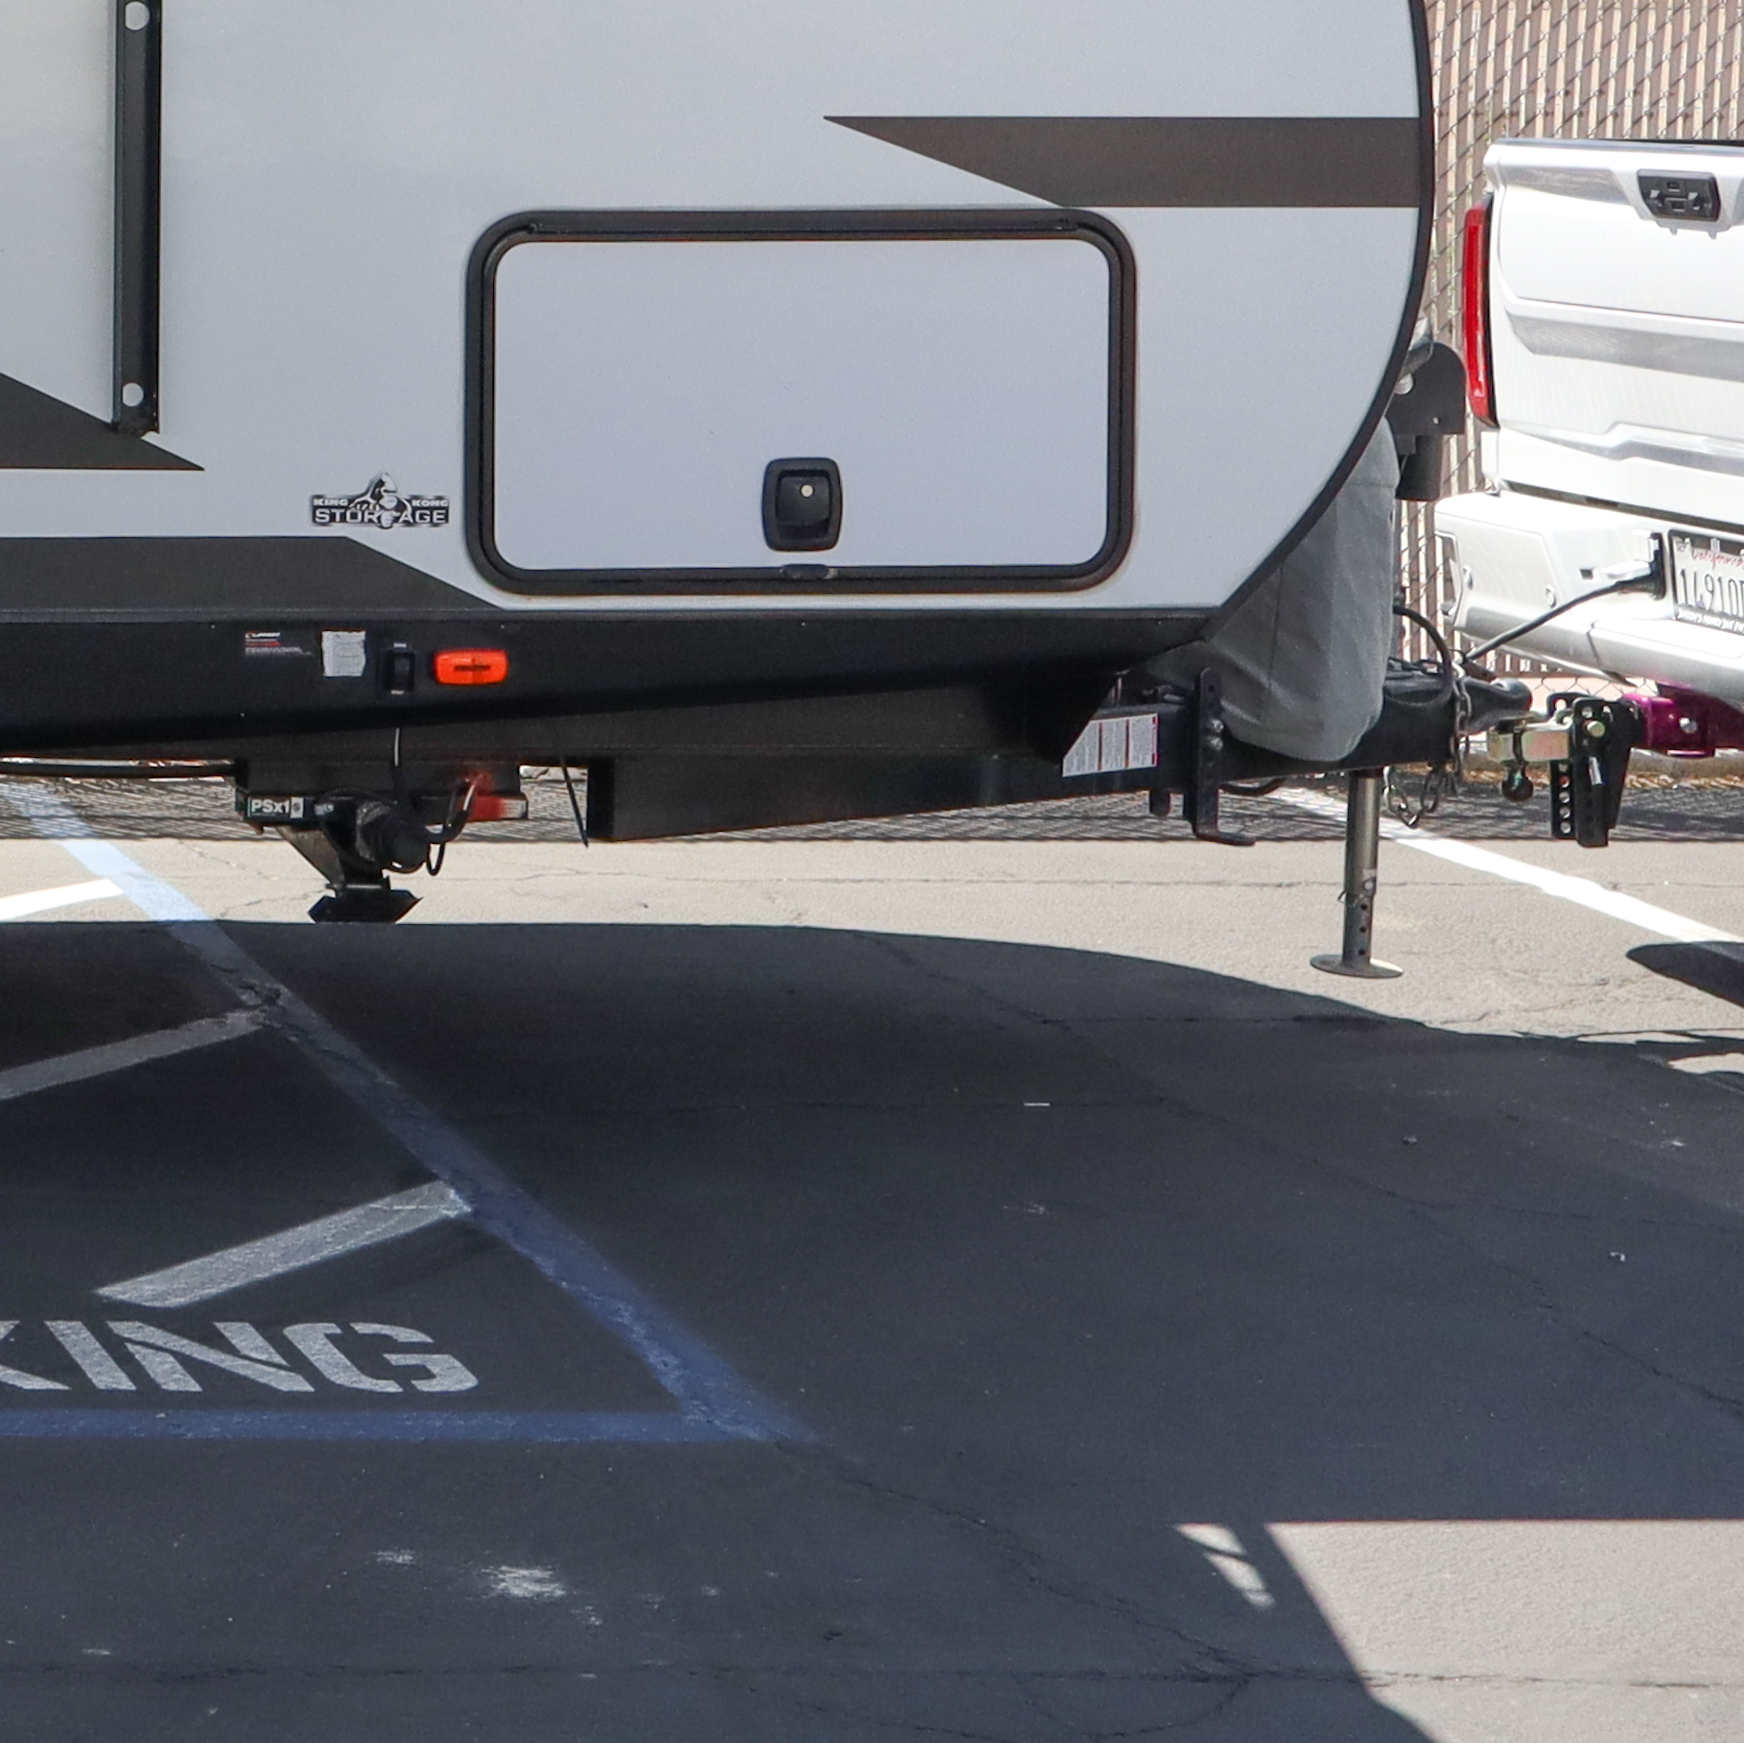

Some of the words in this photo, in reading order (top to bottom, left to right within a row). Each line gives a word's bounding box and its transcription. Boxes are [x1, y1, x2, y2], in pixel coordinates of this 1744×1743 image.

[313, 498, 349, 506] KING
[411, 499, 449, 507] KONG
[251, 798, 290, 814] PSx1
